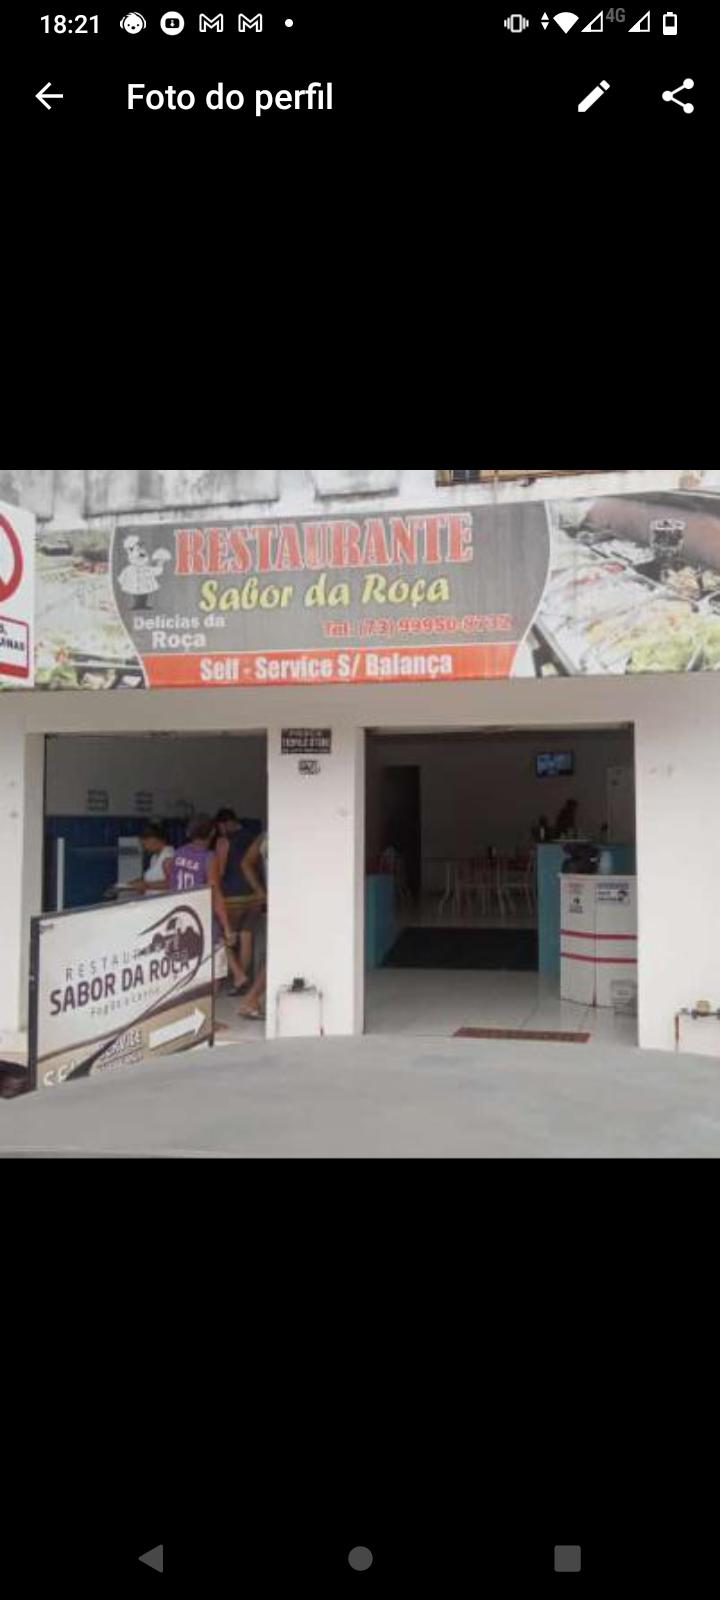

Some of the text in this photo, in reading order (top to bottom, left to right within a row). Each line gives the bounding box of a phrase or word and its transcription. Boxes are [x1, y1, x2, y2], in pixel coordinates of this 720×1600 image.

[174, 512, 474, 575] RESTAURANTE
[200, 573, 450, 612] Sabor da Roça
[204, 612, 226, 629] da
[152, 630, 207, 649] Roça
[200, 655, 239, 682] Self
[255, 653, 333, 680] Service
[337, 652, 360, 679] S/
[365, 650, 453, 677] Balança
[50, 954, 190, 1016] SABOR DA ROÇA
